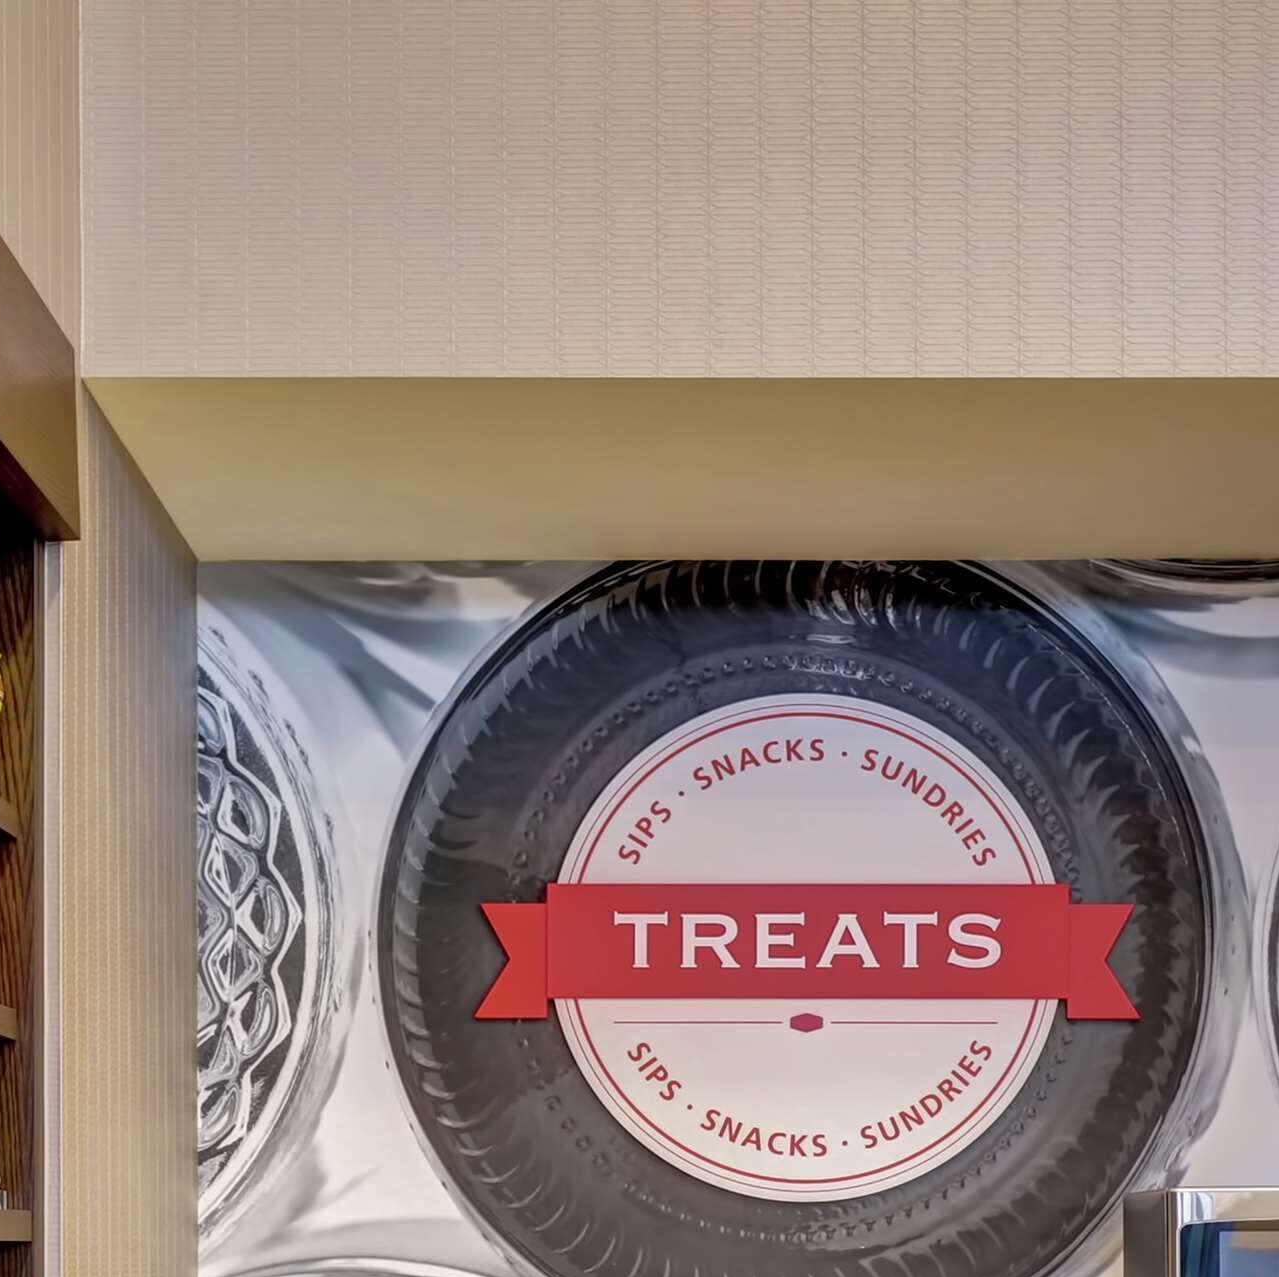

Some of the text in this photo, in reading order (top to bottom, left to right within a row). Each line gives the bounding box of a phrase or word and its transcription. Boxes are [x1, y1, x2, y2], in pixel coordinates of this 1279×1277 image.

[617, 738, 997, 867] SIPS SNACKS SUNDRIES
[613, 910, 1003, 969] TREATS
[626, 1039, 993, 1158] SIPS SNACKS SUNDRIES
